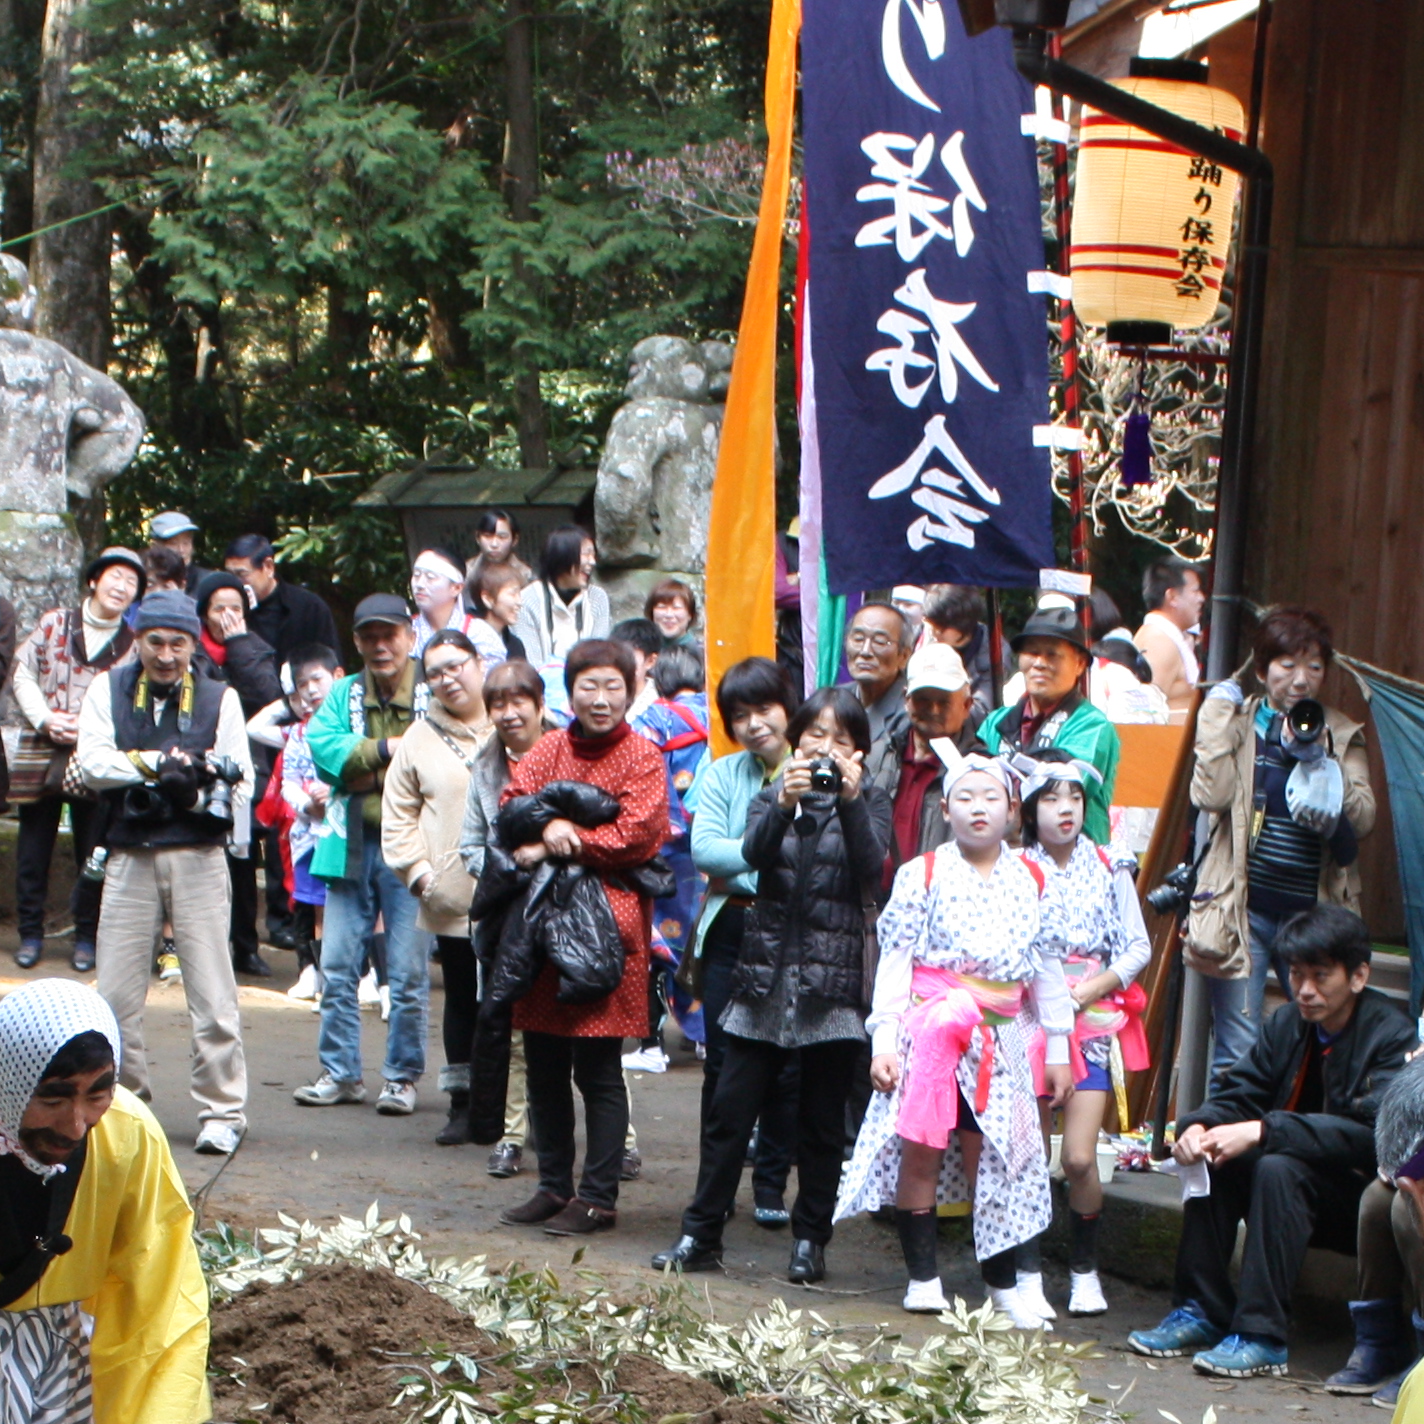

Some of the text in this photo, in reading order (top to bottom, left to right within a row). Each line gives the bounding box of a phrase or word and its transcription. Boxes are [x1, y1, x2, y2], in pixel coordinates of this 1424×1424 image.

[1173, 125, 1224, 300] 踊り保存会
